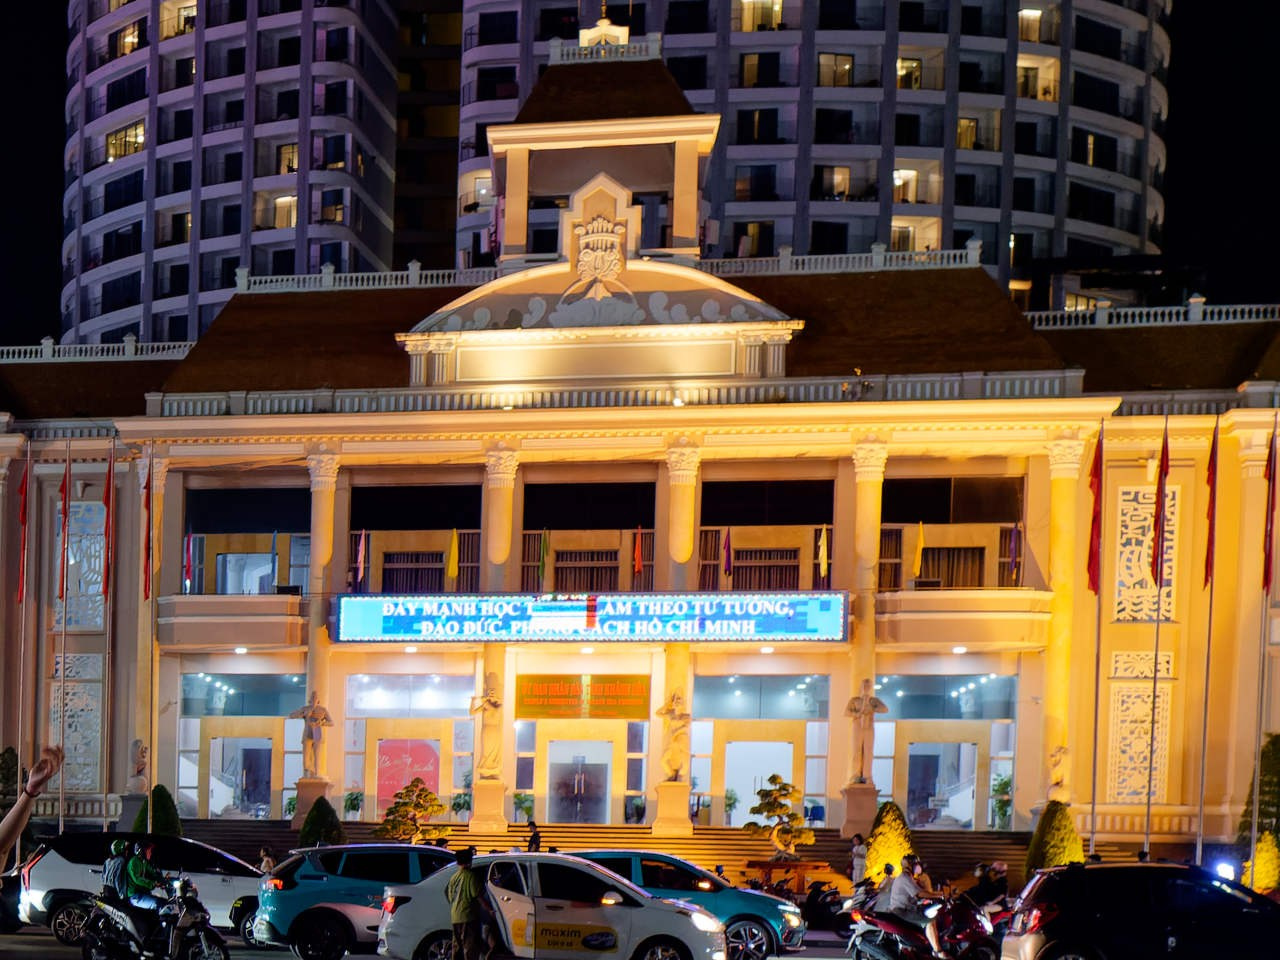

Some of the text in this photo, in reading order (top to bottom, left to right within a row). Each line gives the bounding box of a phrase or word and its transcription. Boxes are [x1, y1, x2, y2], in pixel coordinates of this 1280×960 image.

[422, 601, 477, 621] MẠNH
[479, 601, 519, 620] HỌC
[596, 597, 632, 616] ÀM
[633, 600, 688, 616] THEO
[666, 617, 701, 635] CHÍ
[704, 619, 756, 635] MINH
[540, 927, 582, 939] maxim
